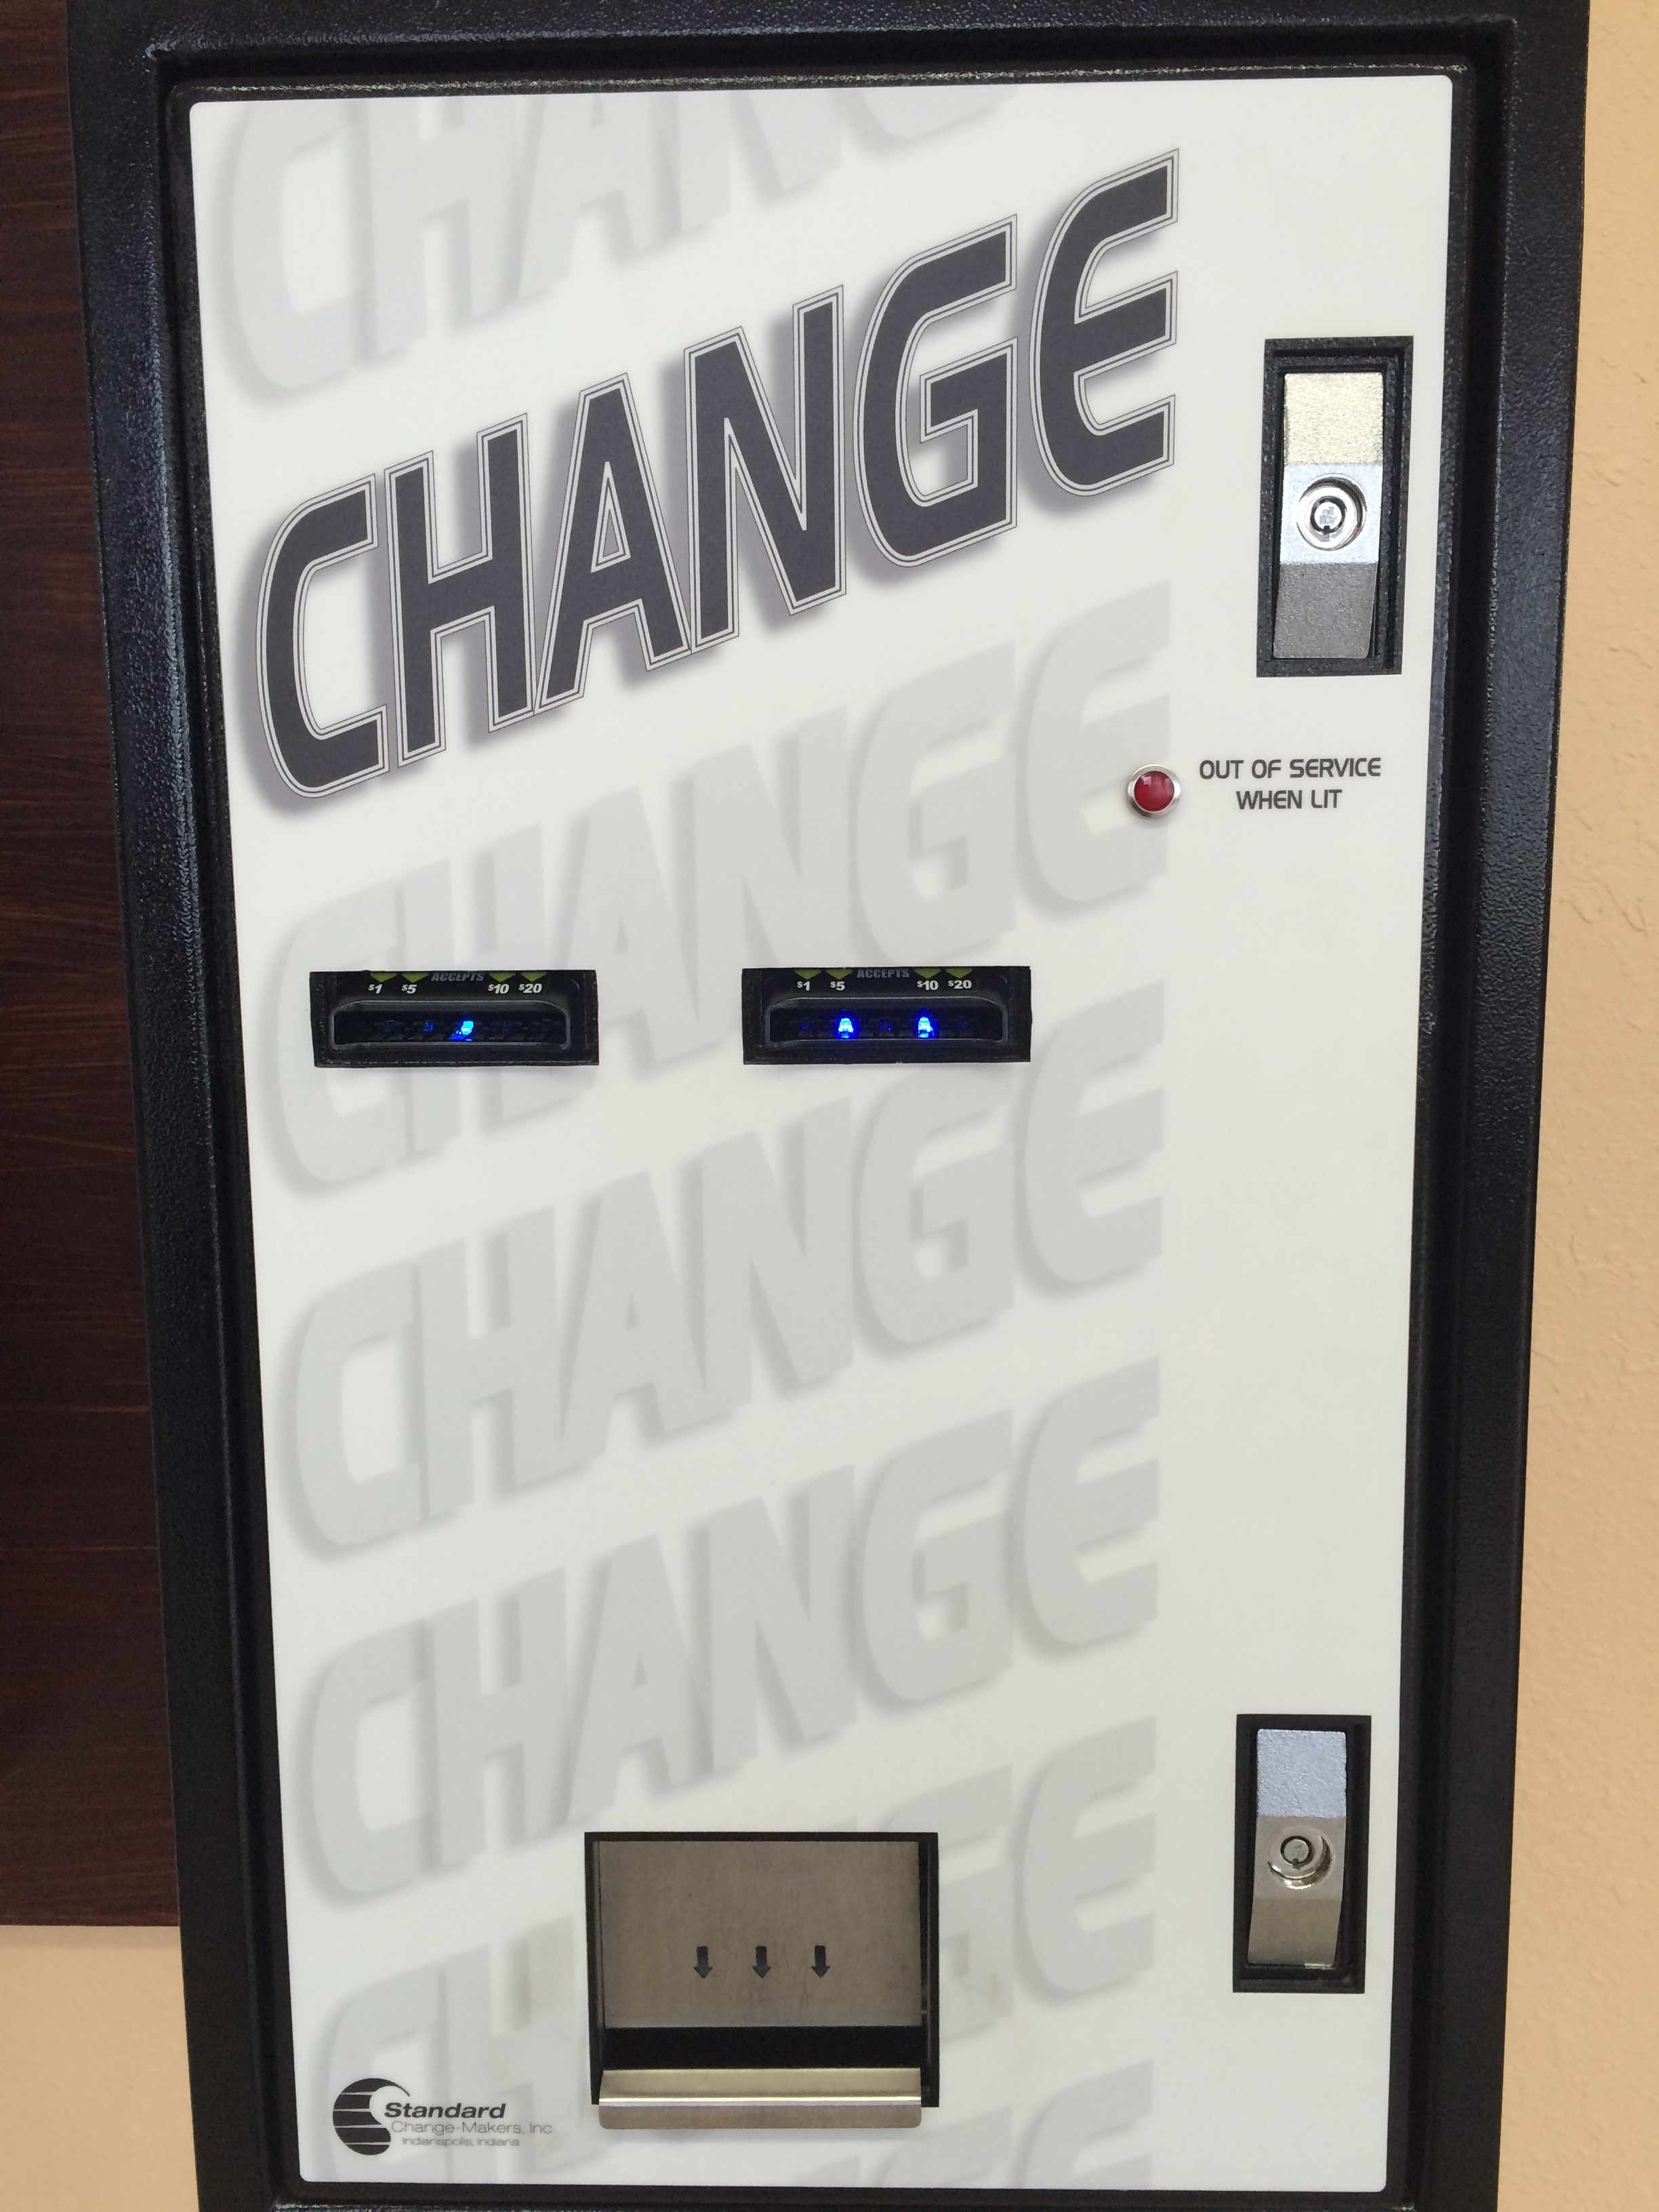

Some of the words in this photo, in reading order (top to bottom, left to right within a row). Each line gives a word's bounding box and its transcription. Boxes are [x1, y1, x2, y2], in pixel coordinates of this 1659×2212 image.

[255, 148, 1179, 798] CHANGE
[1199, 760, 1244, 779] OUT
[1251, 759, 1282, 779] OF
[1289, 757, 1382, 778] SERVICE
[1236, 790, 1303, 810] WHEN
[1311, 789, 1343, 808] LIT
[431, 971, 485, 982] ACCEPTS
[857, 969, 910, 979] ACCEPTS
[367, 984, 383, 994] $1
[401, 984, 417, 994] $5
[487, 984, 510, 994] $10
[518, 983, 543, 994] $20
[796, 981, 811, 991] $1
[830, 981, 846, 991] $5
[917, 981, 939, 991] $10
[948, 980, 972, 989] $20
[295, 981, 1165, 1546] CHANGE
[311, 1356, 1160, 1893] CHANGE
[384, 2102, 506, 2118] Standard
[391, 2121, 525, 2136] Change-Makers,
[402, 2137, 474, 2147] Indianapolis,
[477, 2137, 520, 2147] Indiana
